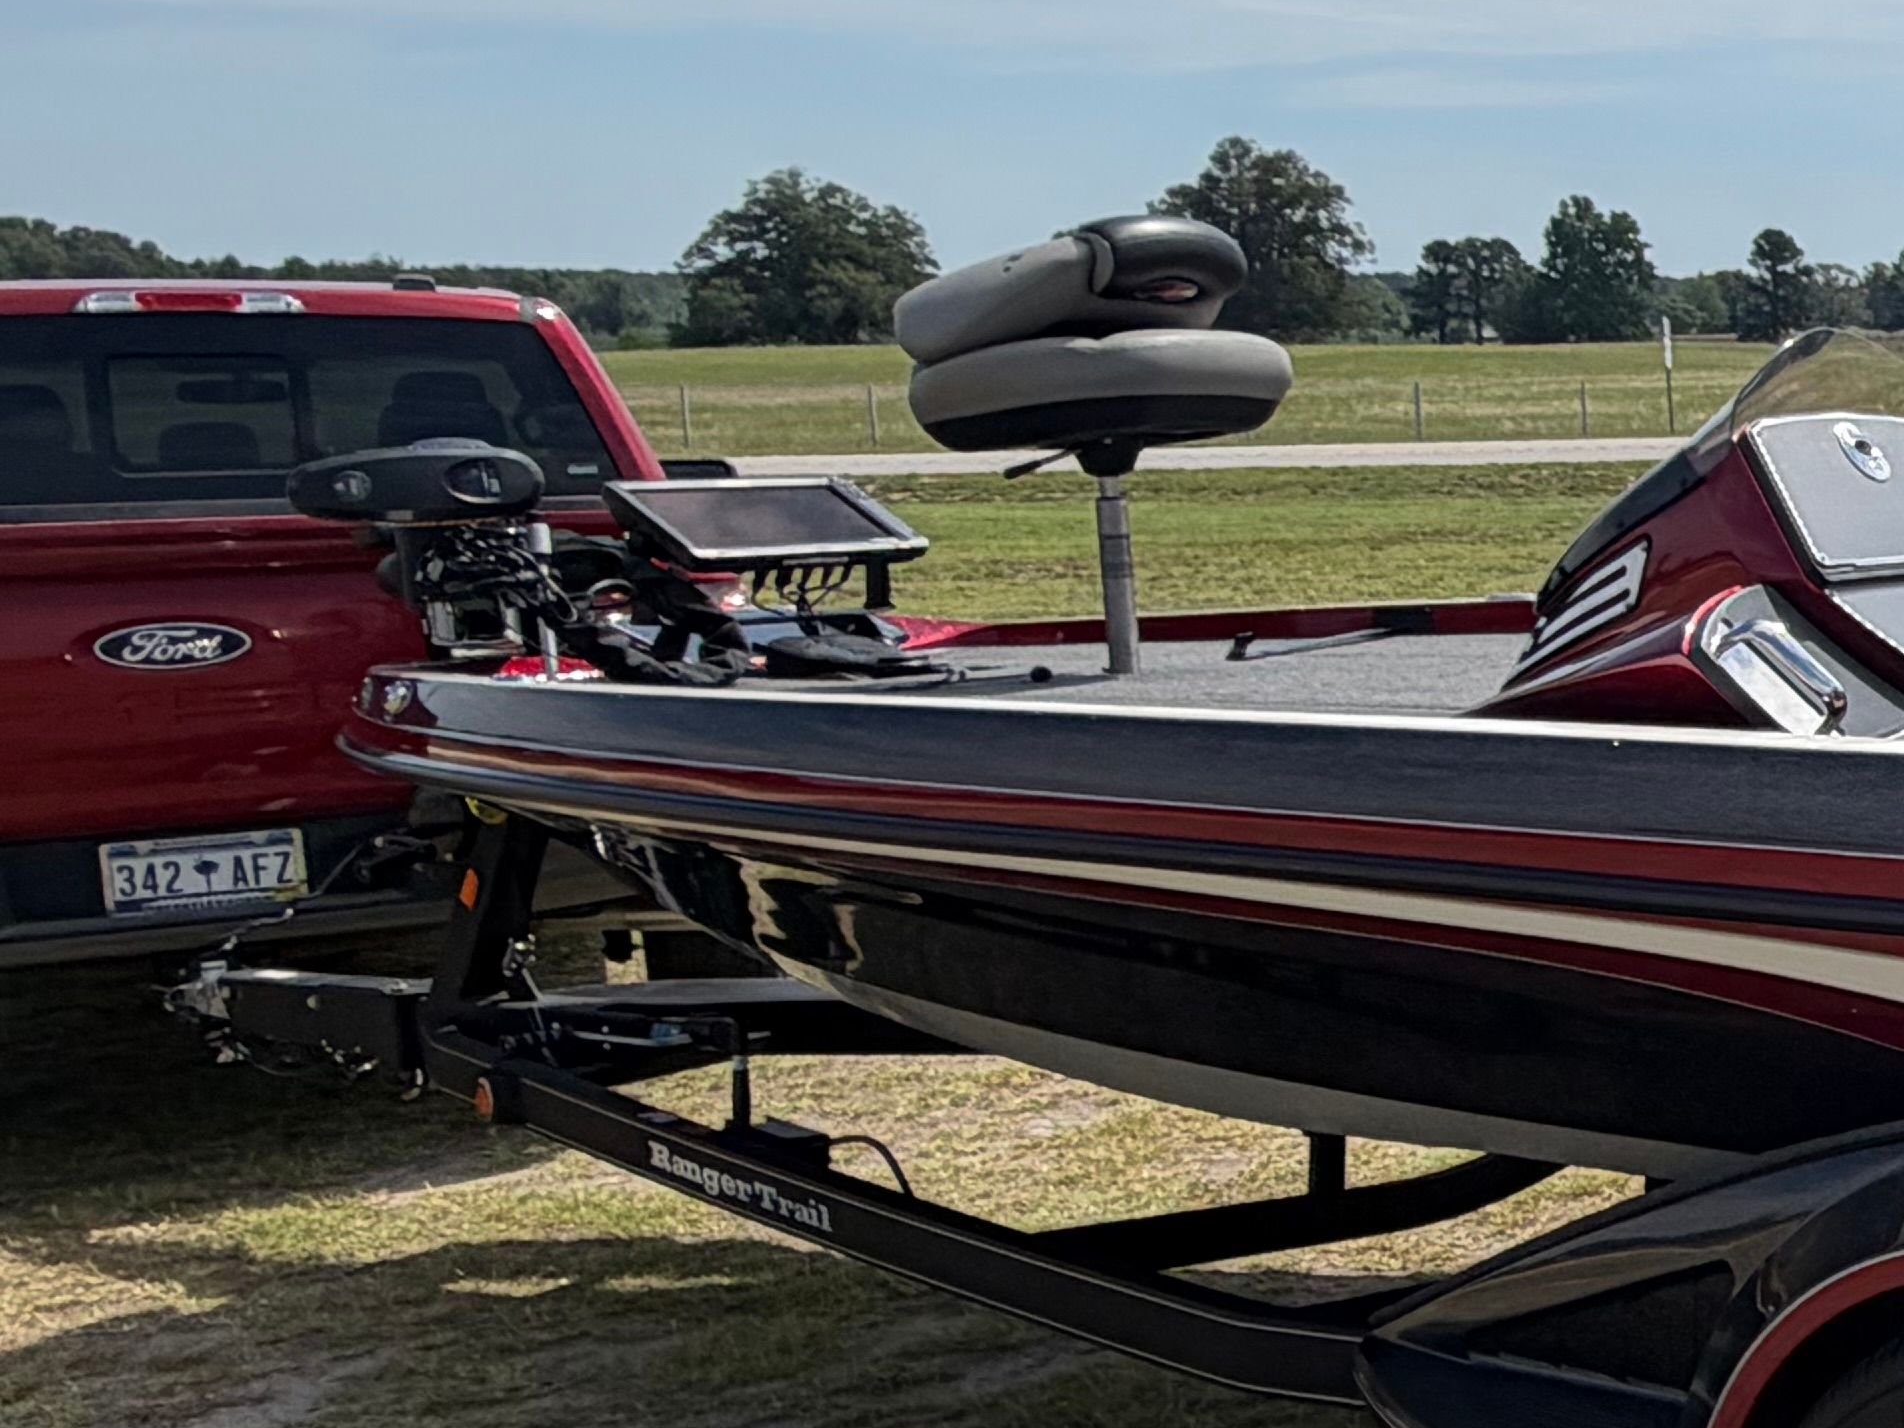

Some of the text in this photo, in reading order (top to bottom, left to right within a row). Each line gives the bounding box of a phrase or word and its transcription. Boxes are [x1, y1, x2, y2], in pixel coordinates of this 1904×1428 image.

[122, 628, 223, 662] Ford
[115, 850, 295, 899] 342 AFZ
[648, 1139, 833, 1233] Ranger Trail
